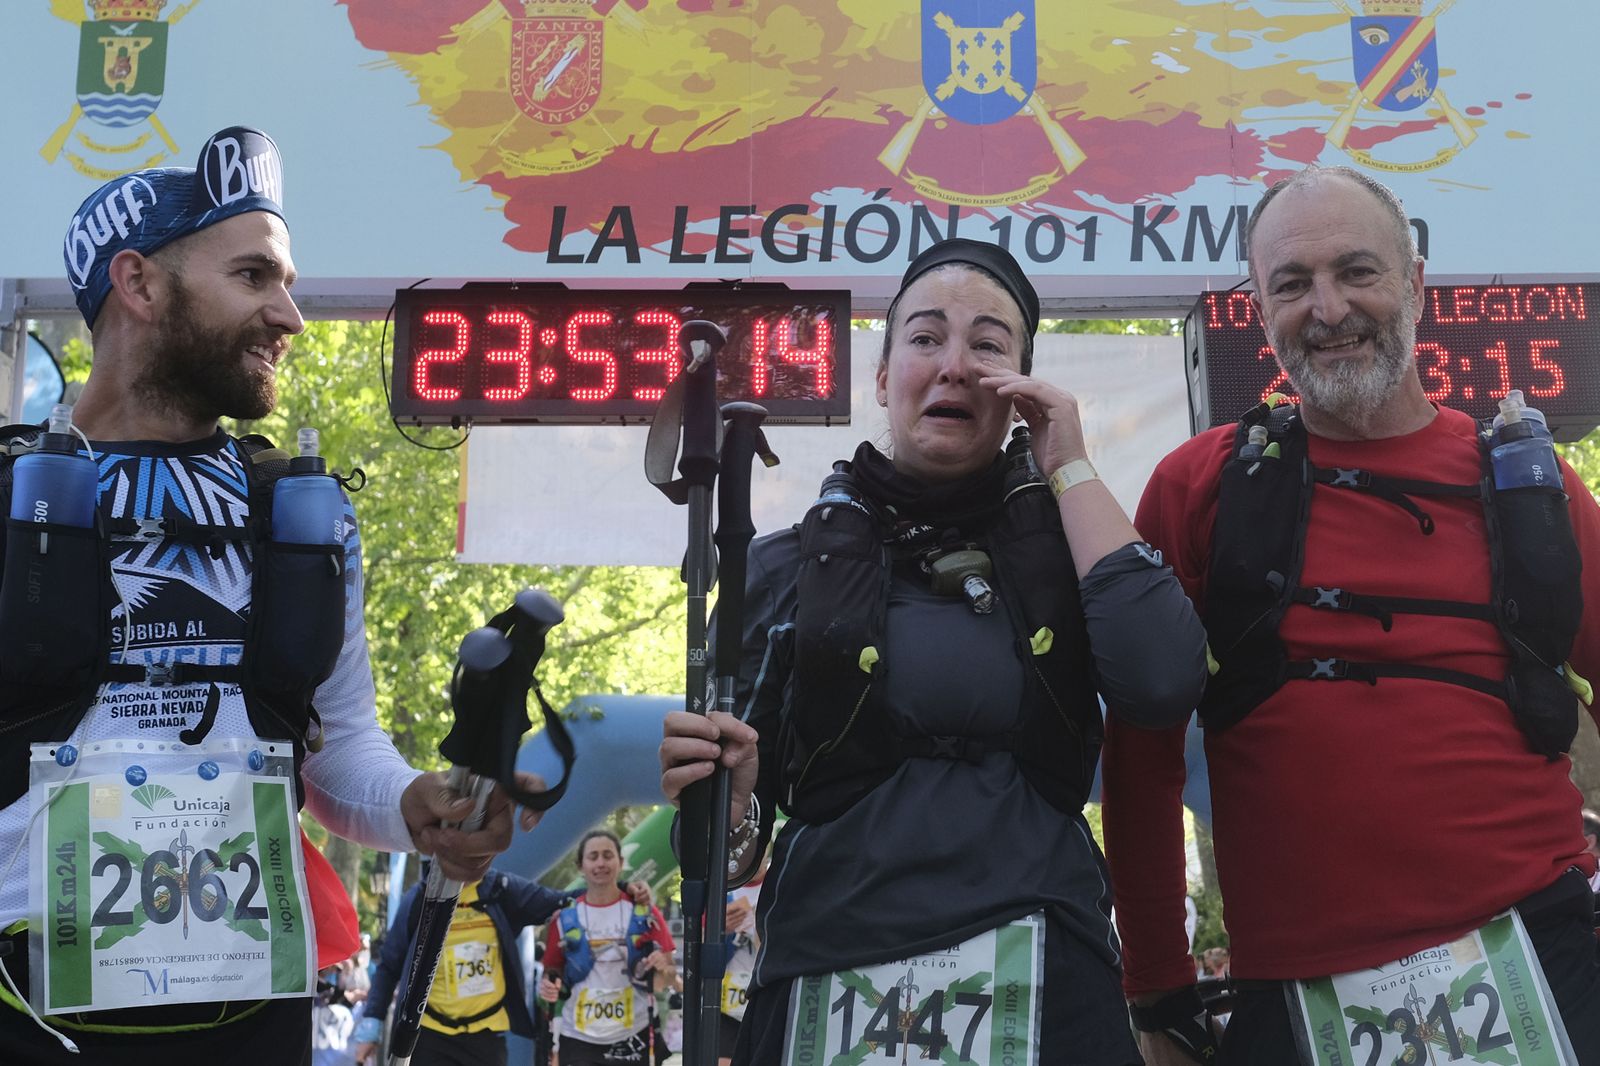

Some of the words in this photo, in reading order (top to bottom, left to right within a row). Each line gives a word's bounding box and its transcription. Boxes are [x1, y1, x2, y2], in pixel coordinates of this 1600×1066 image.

[522, 22, 595, 30] TANTO
[512, 30, 522, 96] MONTA
[588, 31, 602, 96] MONTA
[524, 102, 590, 122] TANTO
[546, 204, 641, 264] LA
[669, 187, 959, 264] LEGIÓN
[989, 214, 1098, 263] 101
[1433, 286, 1588, 324] LEGION
[752, 317, 829, 398] 14
[34, 499, 49, 523] 500
[334, 519, 342, 542] 500
[112, 622, 178, 644] SUBIDA
[185, 620, 207, 638] AL
[162, 688, 209, 701] MOUNTA
[111, 702, 157, 719] SIERRA
[161, 700, 204, 716] NEVAD
[138, 717, 187, 730] GRANADA
[173, 795, 231, 813] Unicaja
[134, 817, 226, 832] Fundación
[268, 837, 282, 871] XXIII
[91, 848, 269, 928] 2662
[272, 875, 294, 934] EDICIÓN
[99, 956, 144, 968] 608851788
[145, 953, 205, 965] EMERGENCIA
[206, 953, 219, 962] DE
[1399, 947, 1450, 968] Unicaja
[1371, 963, 1452, 996] Fundación
[1004, 978, 1019, 1014] XXIII
[1502, 959, 1523, 992] XXIII
[1514, 993, 1542, 1052] EDICIÓN
[584, 1002, 625, 1020] 7006
[831, 985, 993, 1063] 1447
[1351, 982, 1513, 1066] 2312
[1002, 1016, 1017, 1066] EDICIÓ
